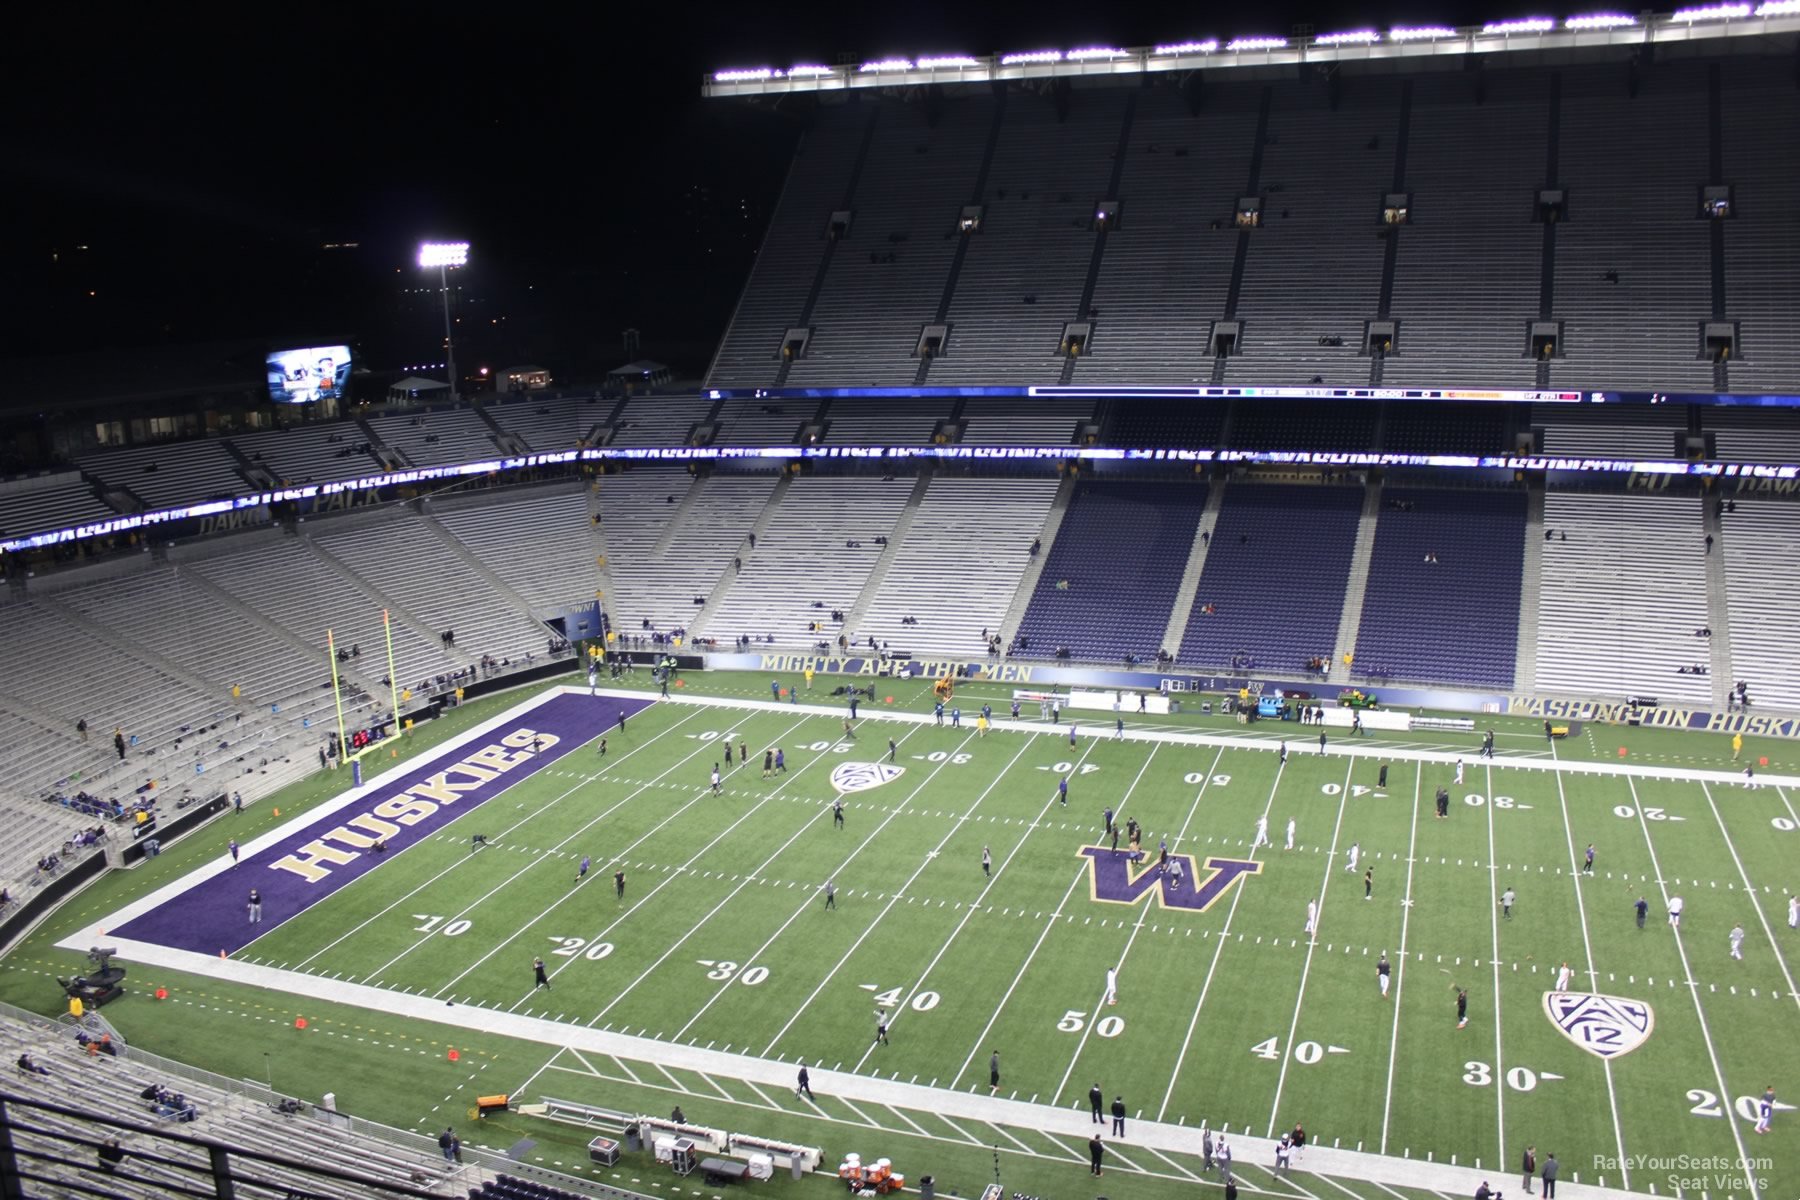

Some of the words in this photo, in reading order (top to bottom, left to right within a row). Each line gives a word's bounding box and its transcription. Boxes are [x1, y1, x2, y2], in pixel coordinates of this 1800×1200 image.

[760, 655, 847, 675] MIGHTY
[974, 662, 1033, 682] MEN
[1507, 695, 1695, 729] WASHINGTON
[927, 751, 973, 765] 30
[1053, 761, 1101, 775] 40
[1183, 771, 1233, 786] 50
[1321, 782, 1372, 799] 40
[267, 727, 561, 884] HUSKIES
[1464, 793, 1514, 810] 30
[1613, 804, 1671, 822] 20
[1075, 844, 1265, 913] W
[414, 915, 473, 937] 10
[552, 936, 615, 962] 20
[707, 960, 770, 986] 30
[874, 985, 942, 1012] 40
[1056, 1009, 1126, 1038] 50
[1583, 1025, 1624, 1047] 12
[1250, 1036, 1325, 1064] 40
[1462, 1060, 1537, 1092] 30
[1685, 1088, 1761, 1123] 20
